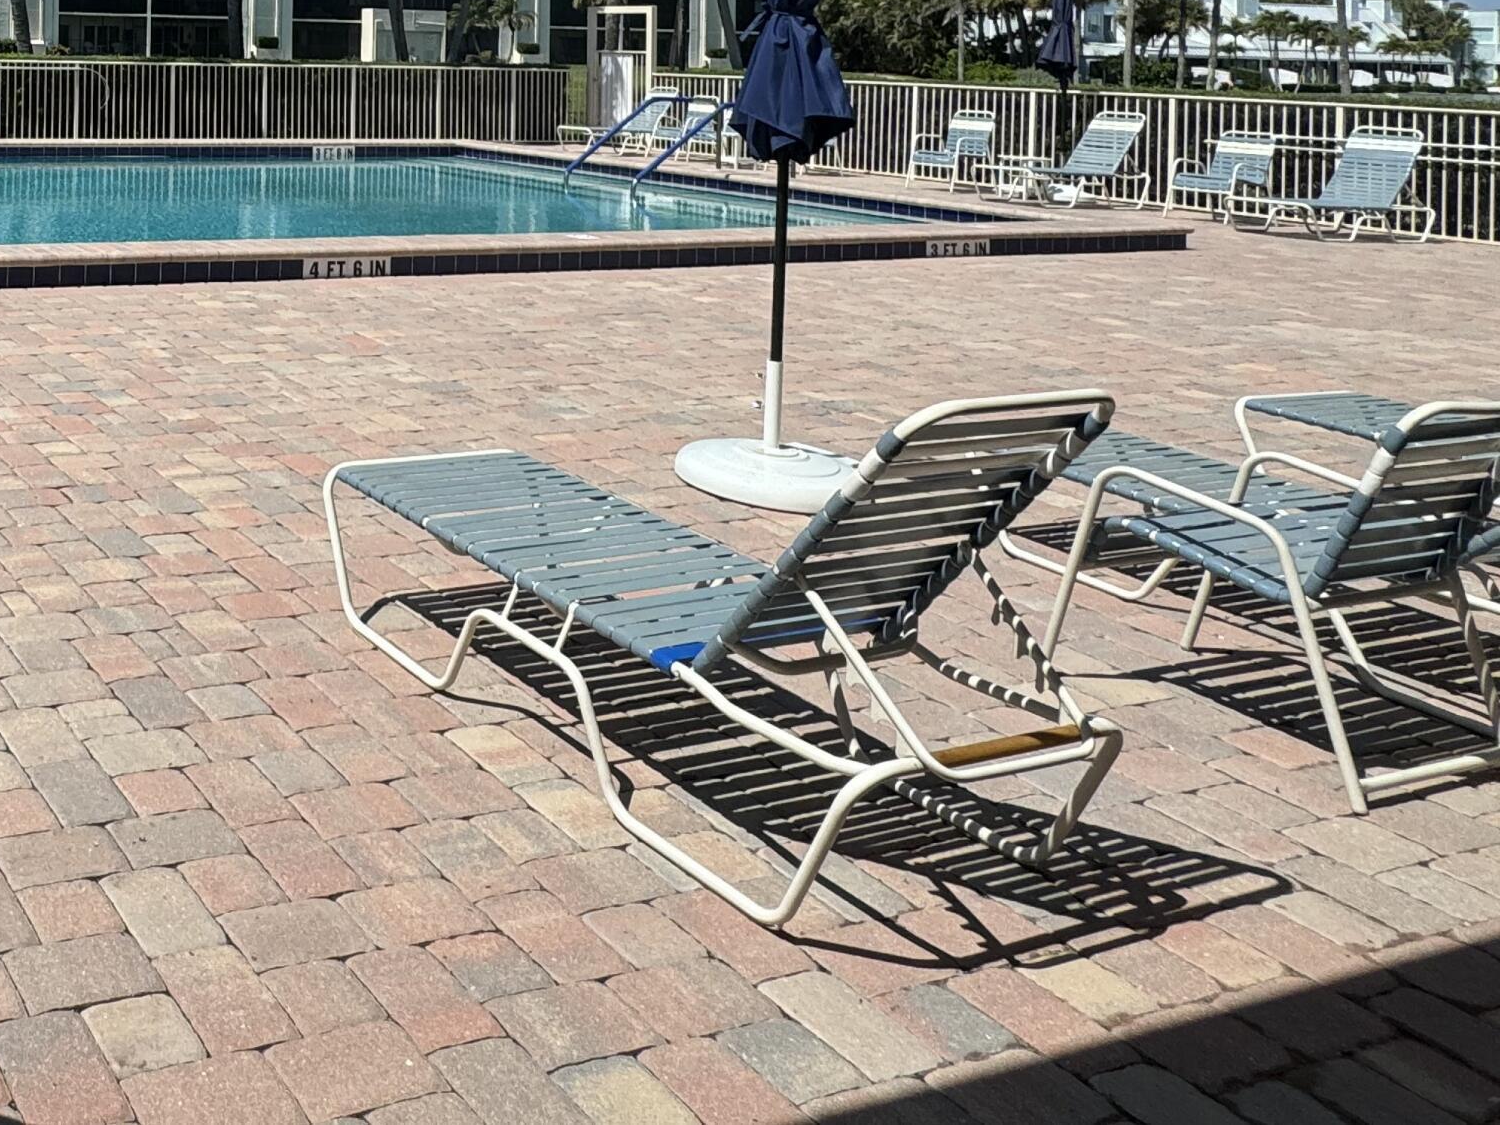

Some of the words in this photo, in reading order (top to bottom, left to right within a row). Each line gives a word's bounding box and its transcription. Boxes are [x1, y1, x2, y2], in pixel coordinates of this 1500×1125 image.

[930, 243, 938, 256] 3
[963, 242, 970, 255] 6
[309, 261, 319, 278] 4
[353, 259, 363, 277] 6
